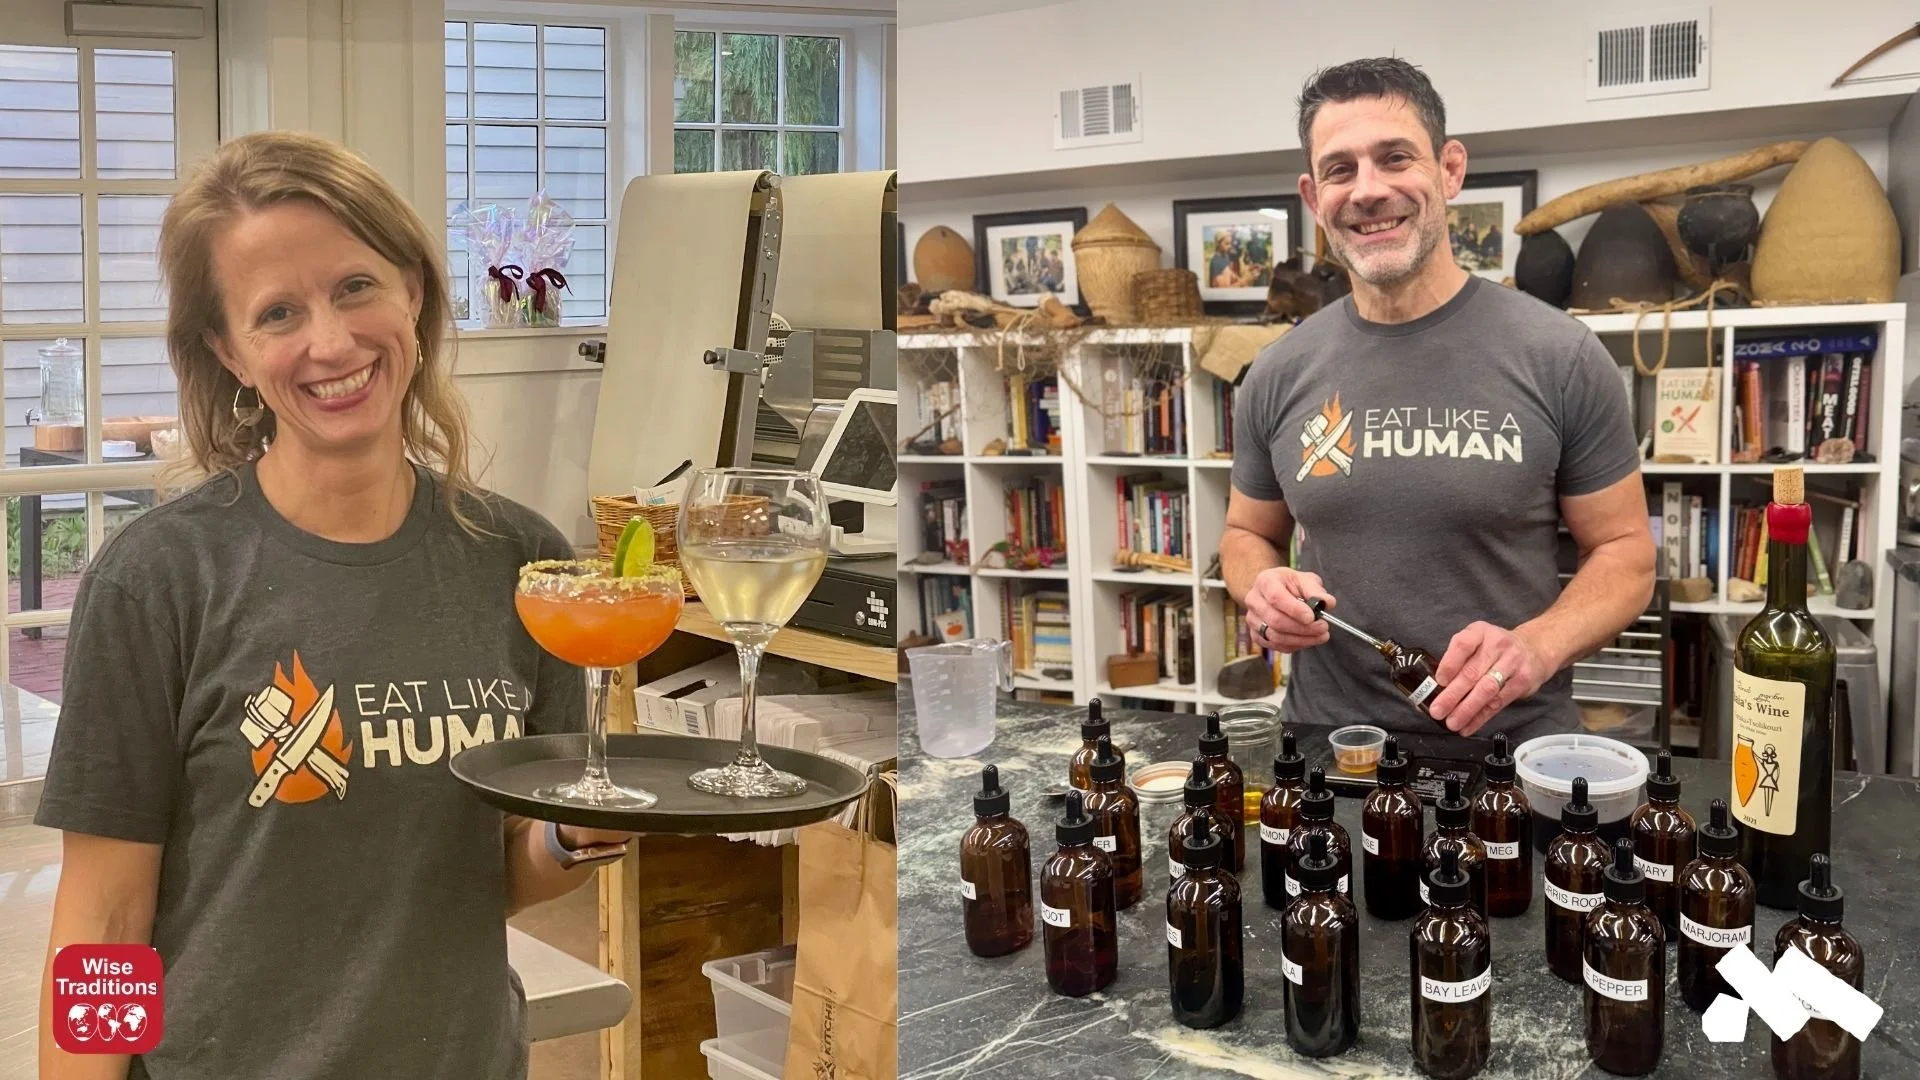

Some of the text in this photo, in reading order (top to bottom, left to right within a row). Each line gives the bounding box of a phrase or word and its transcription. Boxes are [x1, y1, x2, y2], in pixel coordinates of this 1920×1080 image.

[1365, 407, 1521, 433] EAT LIKE A
[1822, 393, 1838, 439] MEAT
[1363, 429, 1523, 463] HUMAN
[355, 680, 428, 716] EAT
[443, 678, 521, 711] LIKE
[1756, 702, 1790, 718] Wine
[1571, 896, 1604, 908] ROOT
[1683, 919, 1747, 943] MARJORAM
[1425, 982, 1450, 998] BAY
[1592, 974, 1643, 996] PEPPER
